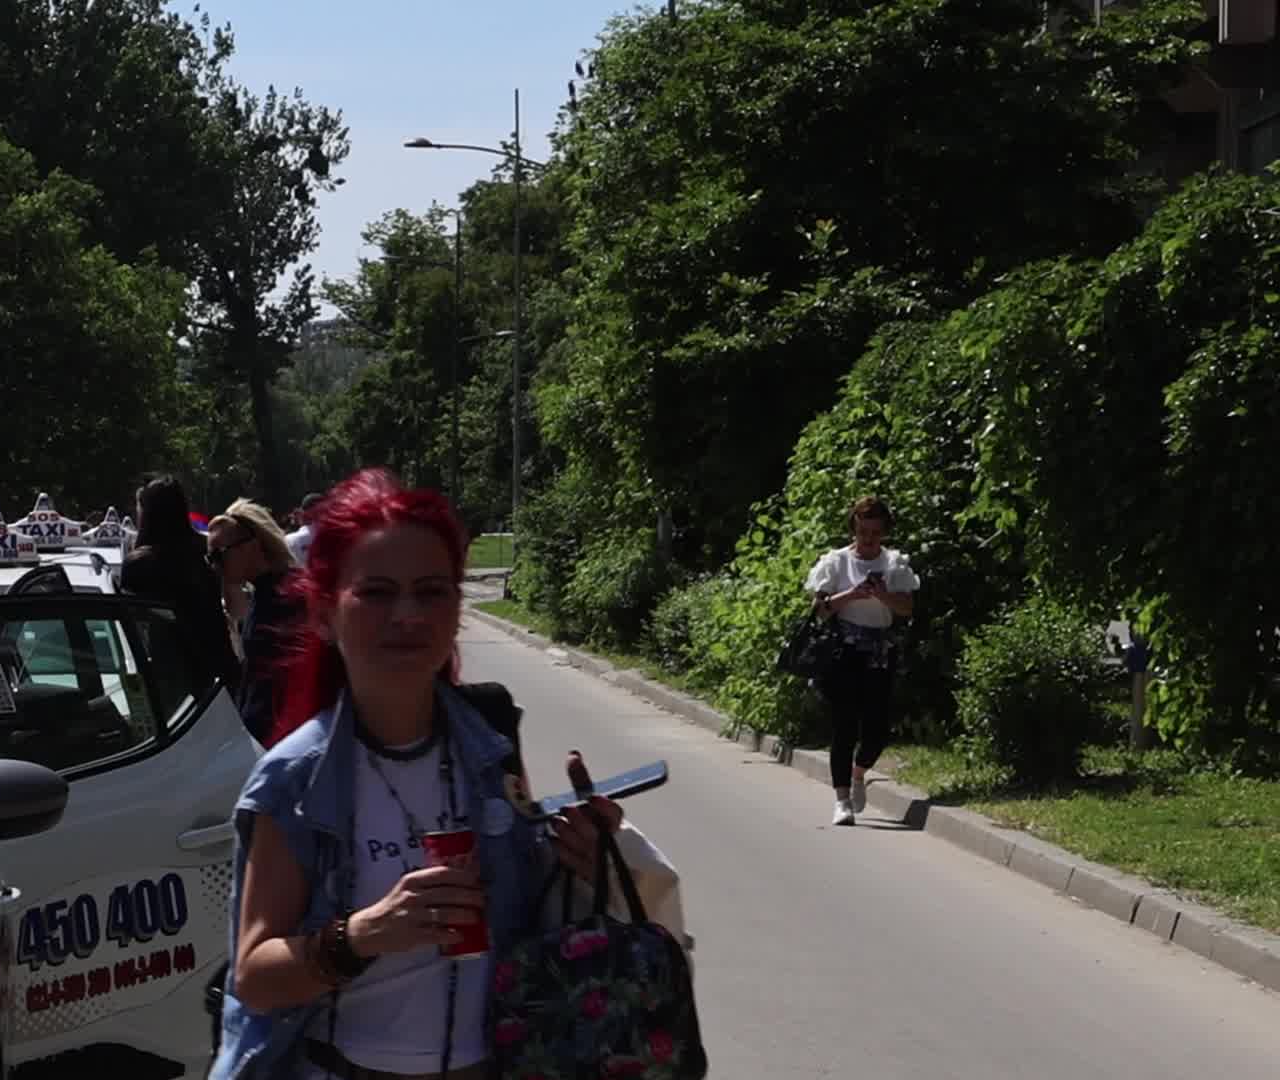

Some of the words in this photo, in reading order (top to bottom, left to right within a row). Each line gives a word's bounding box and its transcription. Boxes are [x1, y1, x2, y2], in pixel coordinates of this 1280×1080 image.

[17, 522, 65, 537] TAXI
[17, 893, 100, 972] 450
[106, 872, 189, 948] 400
